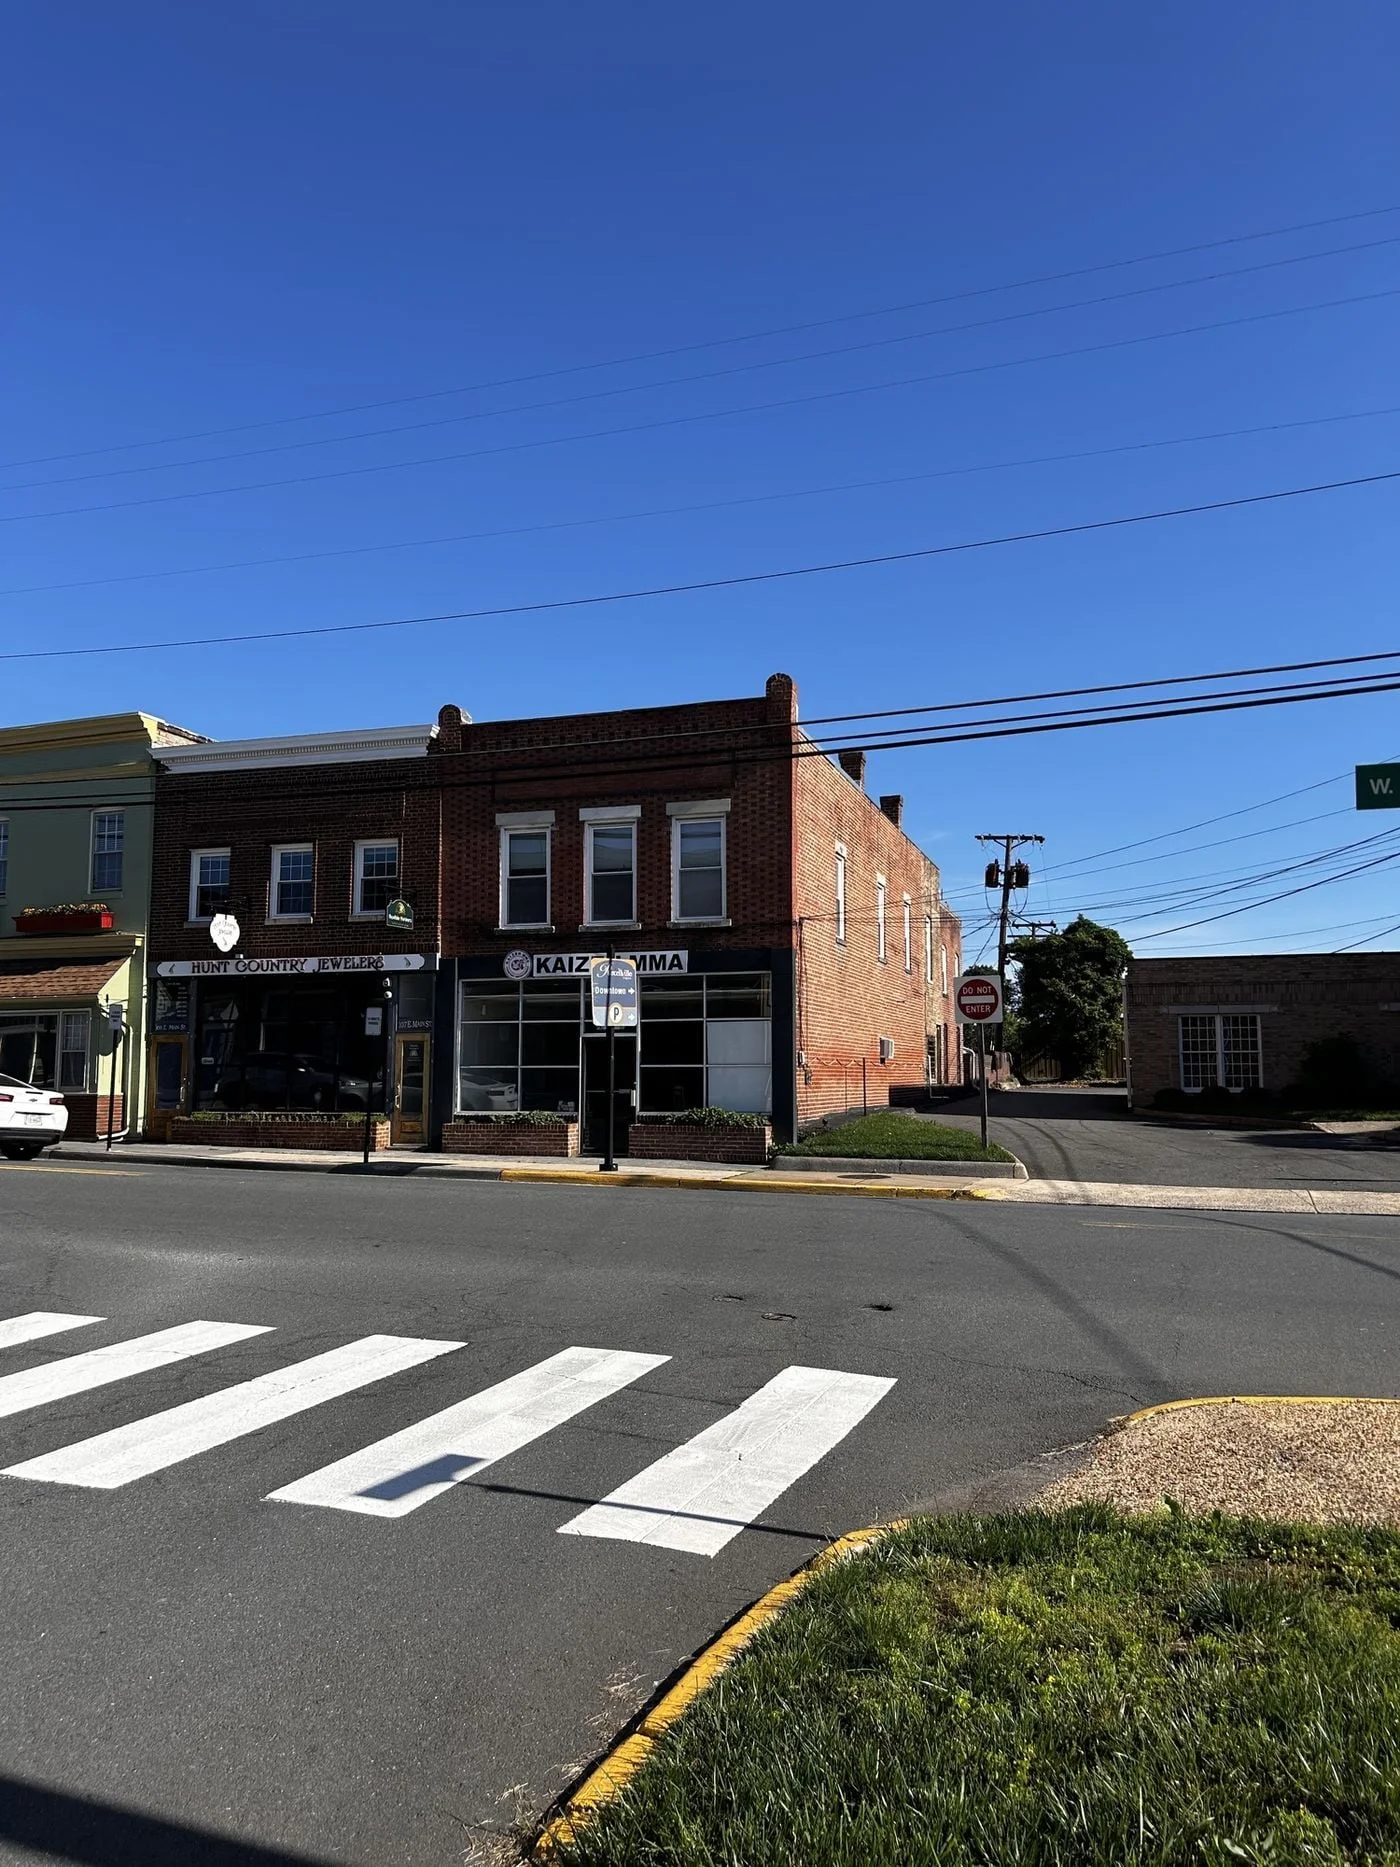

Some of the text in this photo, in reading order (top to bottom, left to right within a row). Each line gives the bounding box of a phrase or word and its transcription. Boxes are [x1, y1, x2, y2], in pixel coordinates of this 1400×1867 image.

[1369, 778, 1394, 795] W.
[192, 956, 385, 974] HUNT COUNTRY JEWELERS
[629, 954, 684, 972] MMA
[976, 986, 992, 994] NOT
[965, 1004, 991, 1013] ENTER
